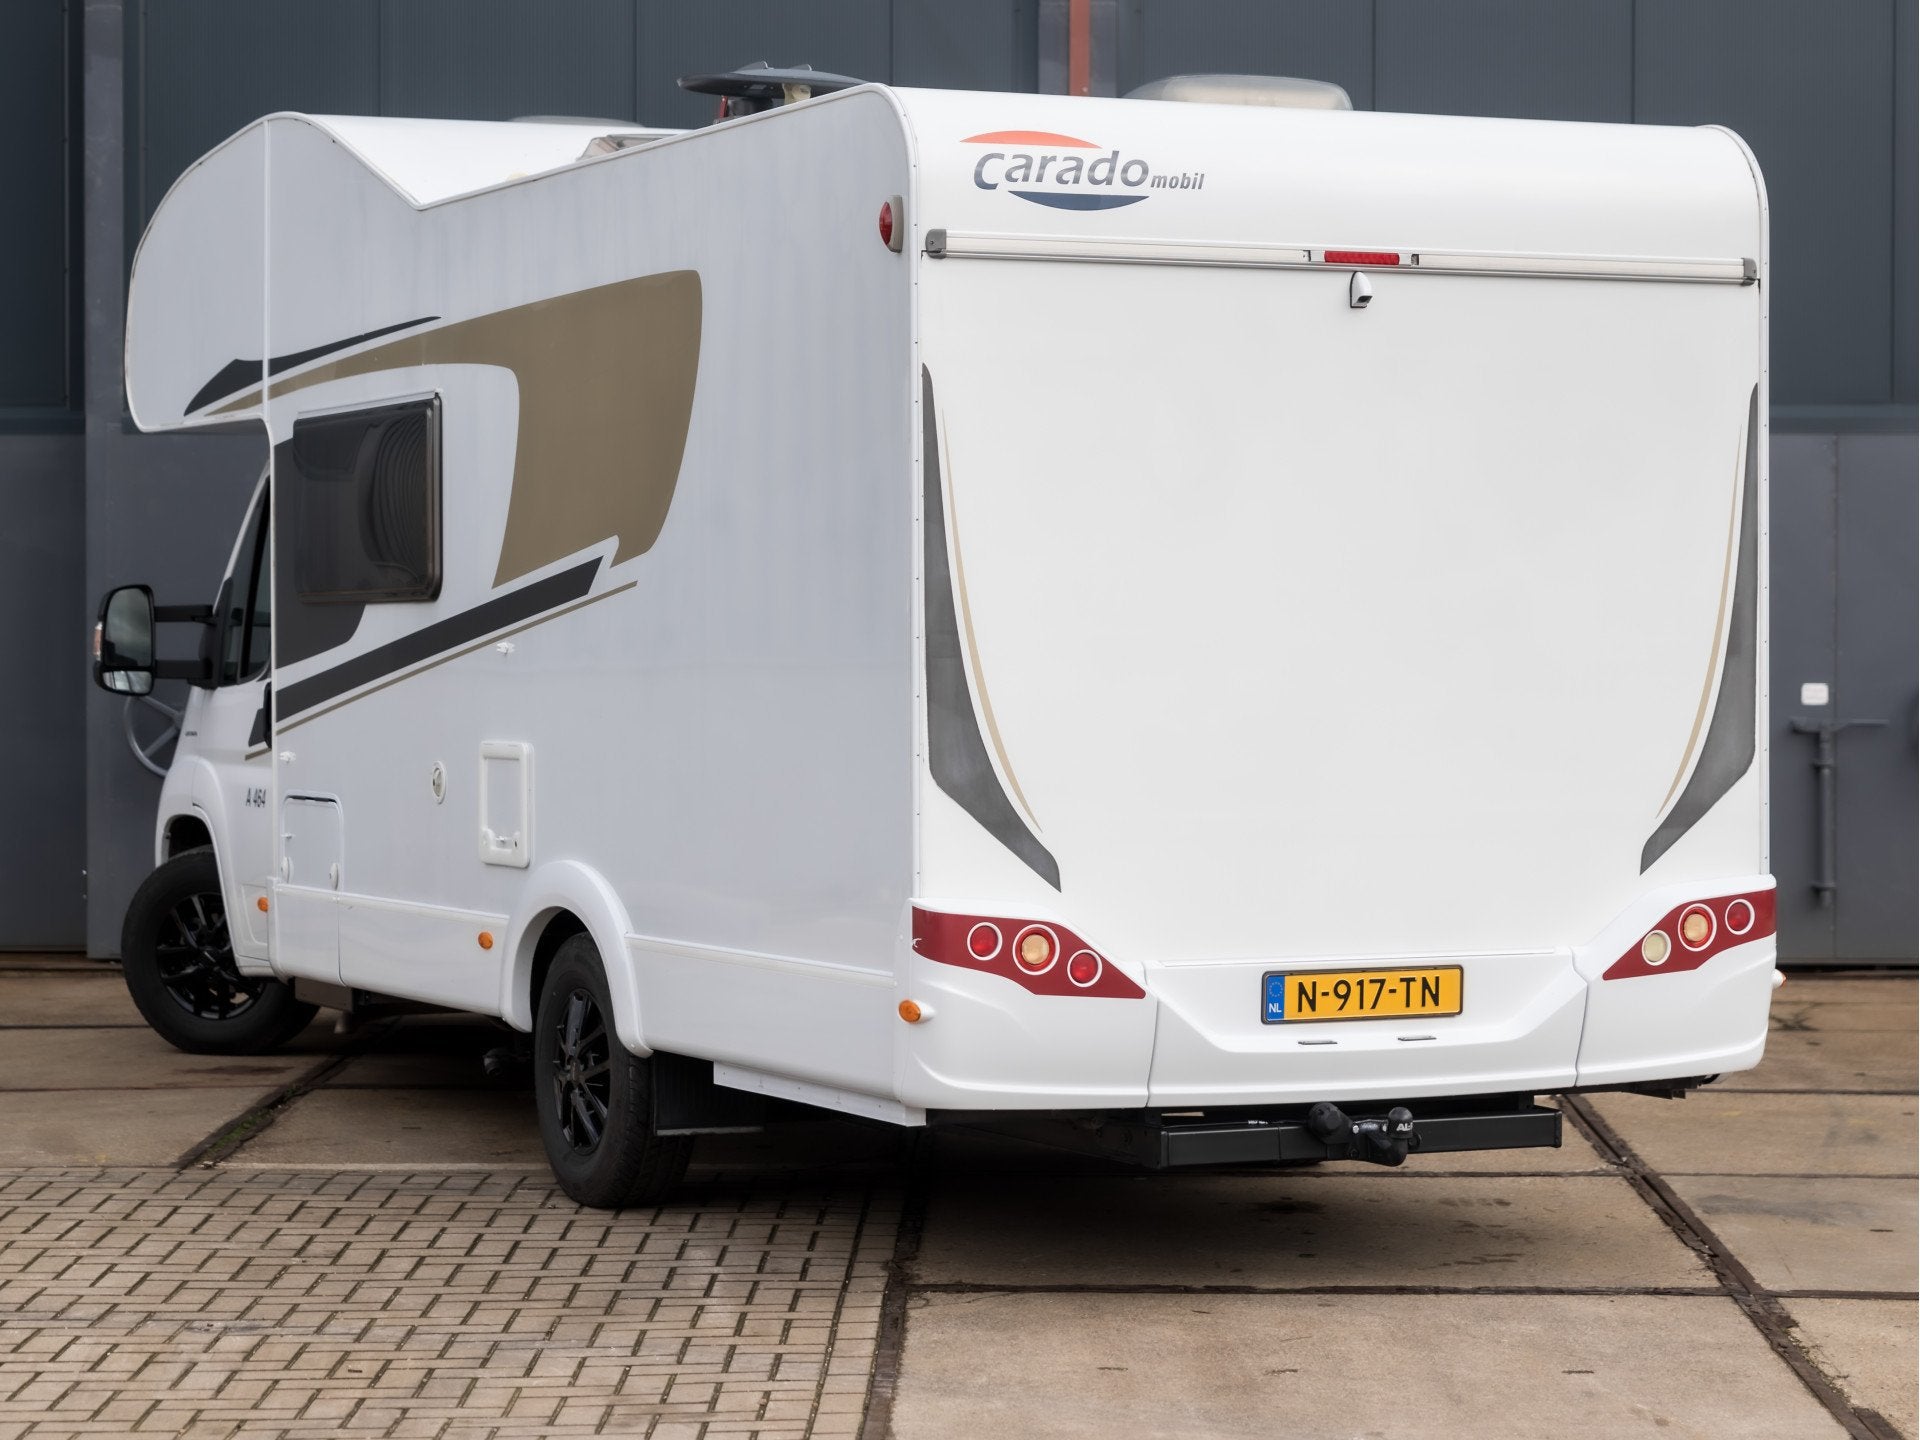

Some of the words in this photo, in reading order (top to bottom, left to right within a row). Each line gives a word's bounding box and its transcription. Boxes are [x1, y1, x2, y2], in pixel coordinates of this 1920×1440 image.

[1150, 172, 1205, 189] mobil
[1297, 975, 1440, 1013] N-917-TN
[1268, 1002, 1282, 1013] NL
